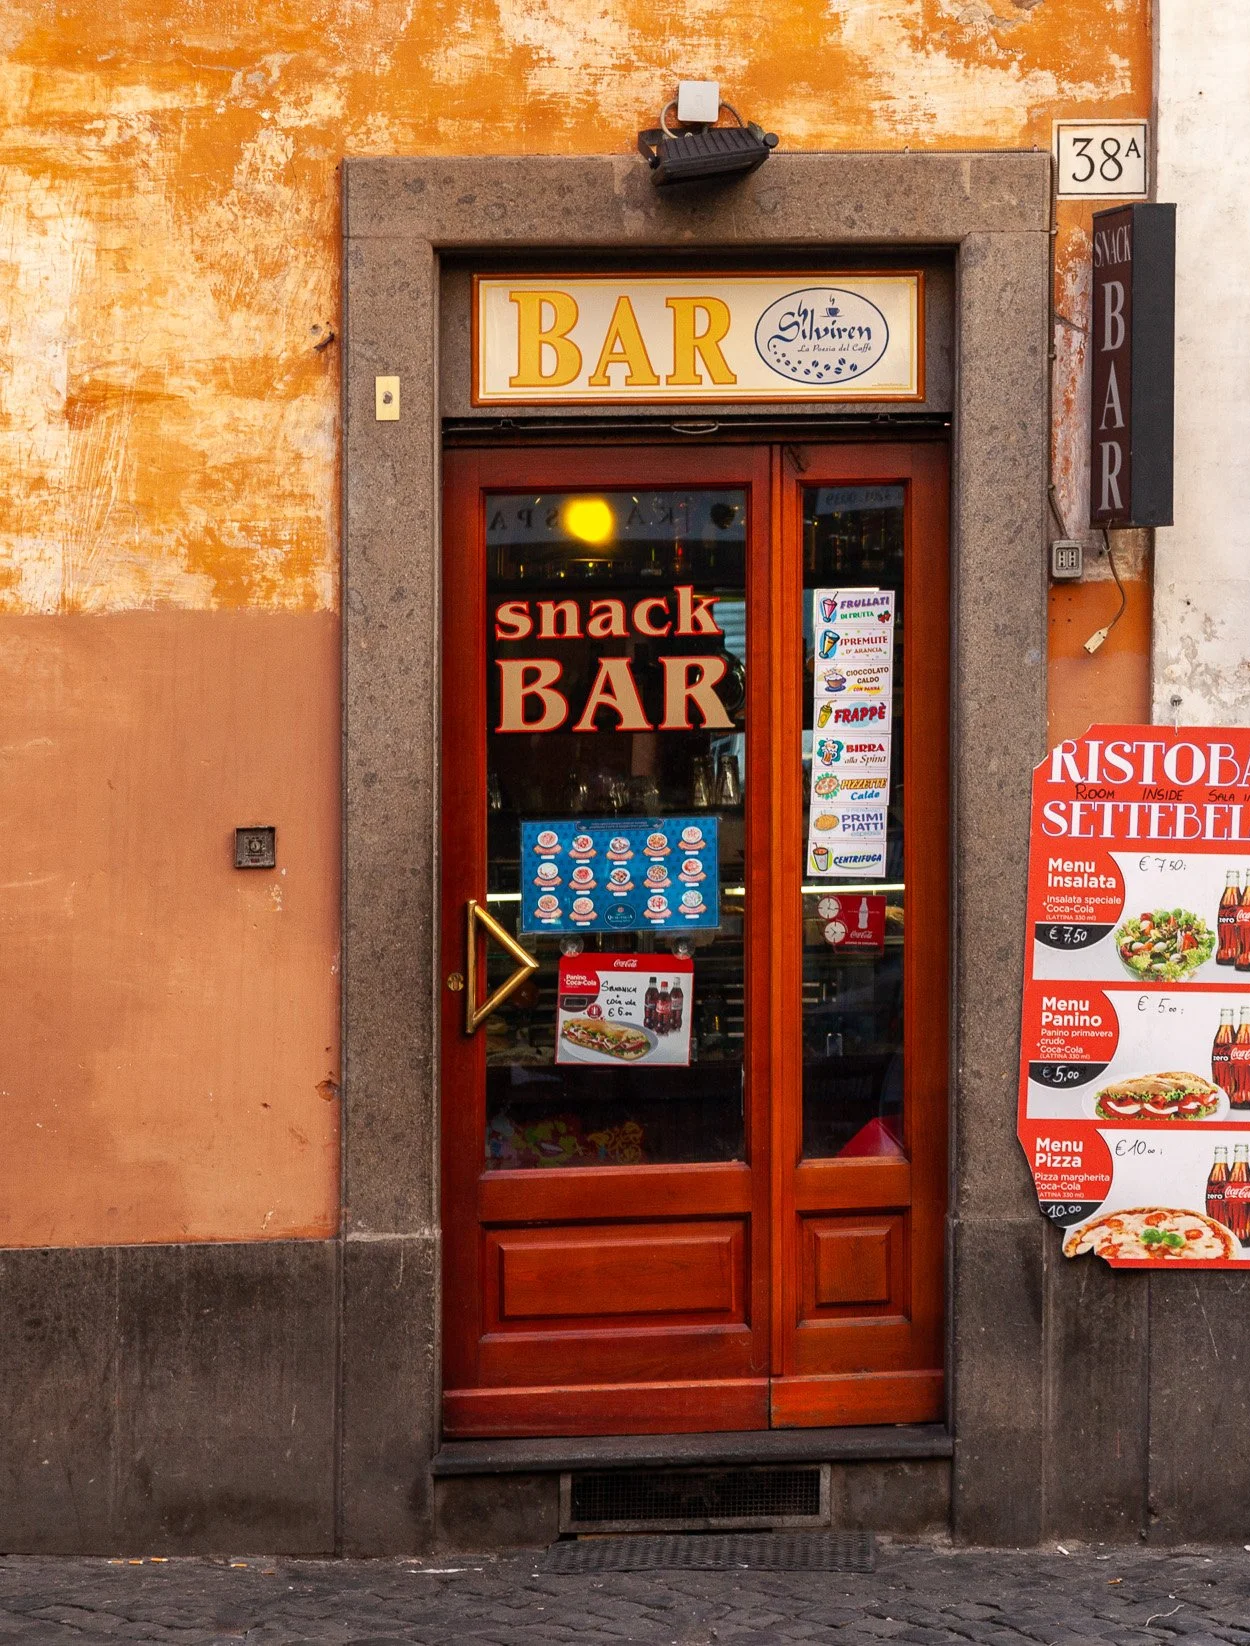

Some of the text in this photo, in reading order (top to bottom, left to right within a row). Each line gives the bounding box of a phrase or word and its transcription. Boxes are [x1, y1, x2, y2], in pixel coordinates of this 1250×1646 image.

[1094, 224, 1132, 268] SNACK
[767, 299, 872, 352] Silviren
[509, 290, 738, 388] BAR
[839, 344, 850, 352] del
[1099, 280, 1126, 511] BAR
[840, 596, 890, 609] FRULLATI
[494, 584, 723, 641] snack
[849, 611, 875, 619] FRUTTA
[839, 635, 889, 647] SPREMUTE
[846, 666, 889, 677] CIOCCOLATO
[857, 676, 880, 684] CALDO
[494, 655, 736, 733] BAR
[834, 702, 887, 724] FRAPPÈ
[846, 743, 885, 753] BIRRA
[859, 754, 887, 766] Spina
[840, 778, 888, 791] PIZZETTE
[1075, 783, 1115, 800] ROOM
[1142, 787, 1184, 801] INSIDE
[1208, 790, 1235, 803] SALA
[841, 813, 883, 823] PRIMI
[842, 822, 884, 832] PIATTI
[833, 853, 882, 865] CENTRIFUGA
[1048, 858, 1096, 872] Menu
[1139, 855, 1150, 871] €
[1047, 873, 1117, 889] Insalata
[1047, 895, 1122, 906] Insalata speciale
[1046, 904, 1095, 913] Coca-Cola
[1049, 926, 1058, 940] €
[1042, 997, 1090, 1011] Menu
[1137, 995, 1149, 1011] €
[1041, 1012, 1103, 1027] Panino
[1040, 1028, 1113, 1041] Panino primavera
[1040, 1036, 1065, 1045] crudo
[1039, 1045, 1084, 1054] Coca-Cola
[1036, 1137, 1083, 1152] Menu
[1035, 1152, 1082, 1168] Pizza
[1034, 1172, 1110, 1183] Pizza margherita
[1035, 1182, 1081, 1190] Coca-Cola
